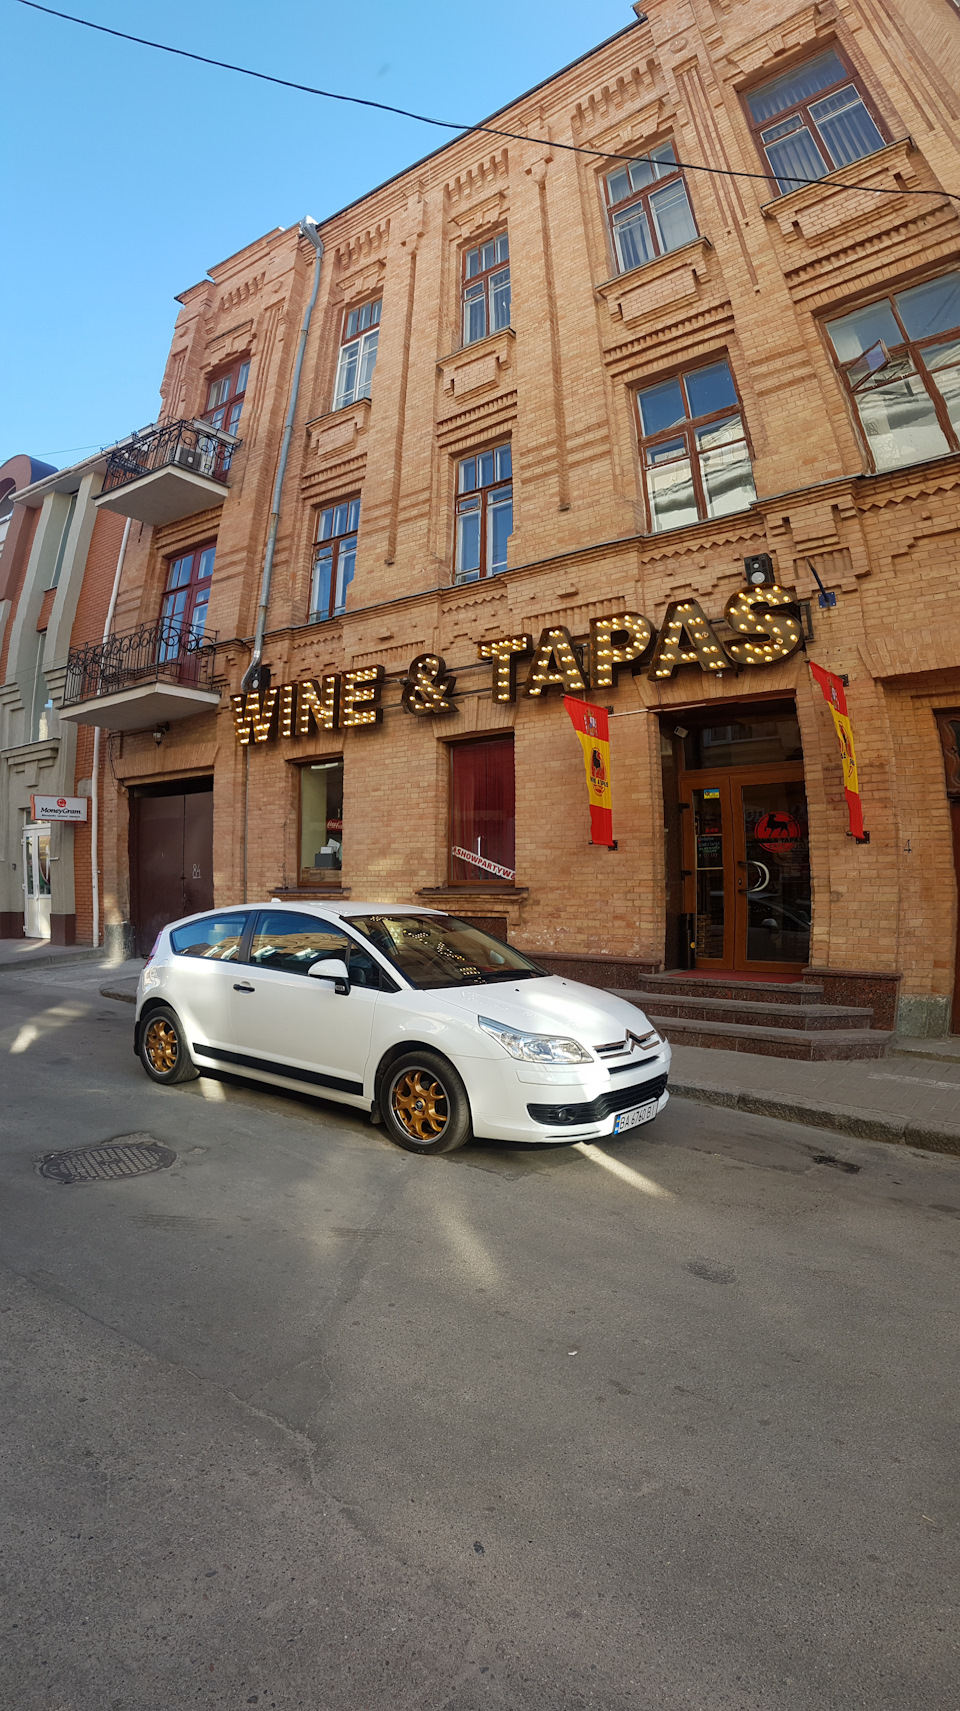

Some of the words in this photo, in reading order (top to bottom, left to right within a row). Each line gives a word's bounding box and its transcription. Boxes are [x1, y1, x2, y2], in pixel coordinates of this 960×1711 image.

[230, 664, 385, 745] WINE
[402, 653, 460, 717] &
[477, 582, 802, 704] TAPAS
[620, 1115, 629, 1129] BA
[631, 1109, 646, 1124] 6760
[647, 1105, 655, 1118] BI
